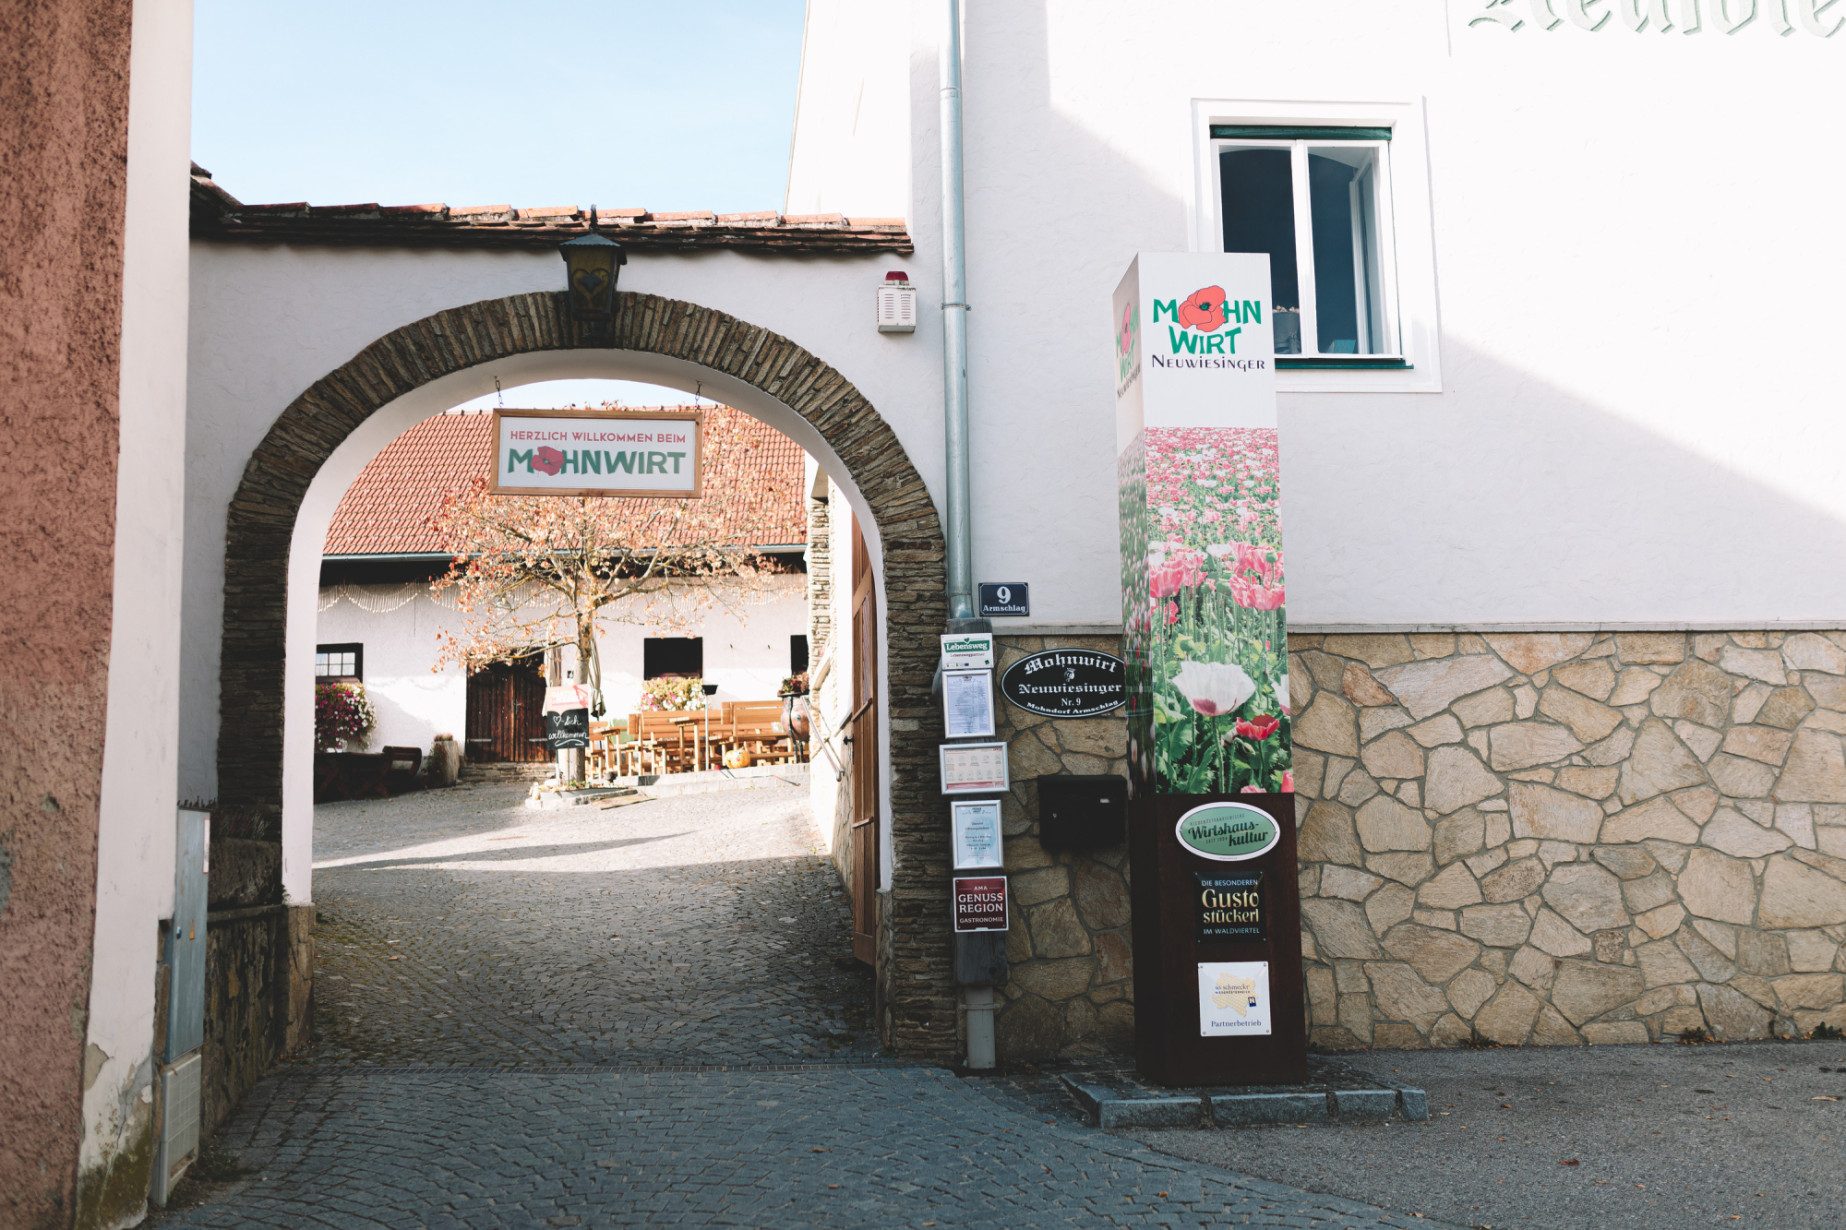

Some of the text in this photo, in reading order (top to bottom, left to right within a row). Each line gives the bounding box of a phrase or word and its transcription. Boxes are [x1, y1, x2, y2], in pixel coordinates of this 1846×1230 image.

[1168, 325, 1242, 354] WIRT
[510, 430, 686, 443] HERZLICH WILLKOMMEN BEIM
[996, 586, 1012, 604] 9
[982, 604, 1026, 613] Armschlag
[945, 642, 988, 651] Lebensweg
[1024, 653, 1117, 675] Mohnwirt
[1018, 682, 1122, 695] Neuwiesinger
[1026, 700, 1119, 715] Mohndorf Armschlag
[1061, 697, 1081, 707] Nr. 9
[1188, 821, 1260, 841] Wirtshaus-
[1228, 831, 1269, 847] kultur
[1215, 879, 1259, 887] BESONDEREN
[958, 892, 1004, 903] GENUSS
[1201, 888, 1260, 909] Gusto
[959, 903, 1003, 913] REGION
[959, 916, 1004, 924] GASTRONOMIE
[1203, 908, 1260, 924] stückerl
[1215, 927, 1260, 935] WALDVIERTEL
[1211, 1019, 1262, 1028] Partnerbetrieb
